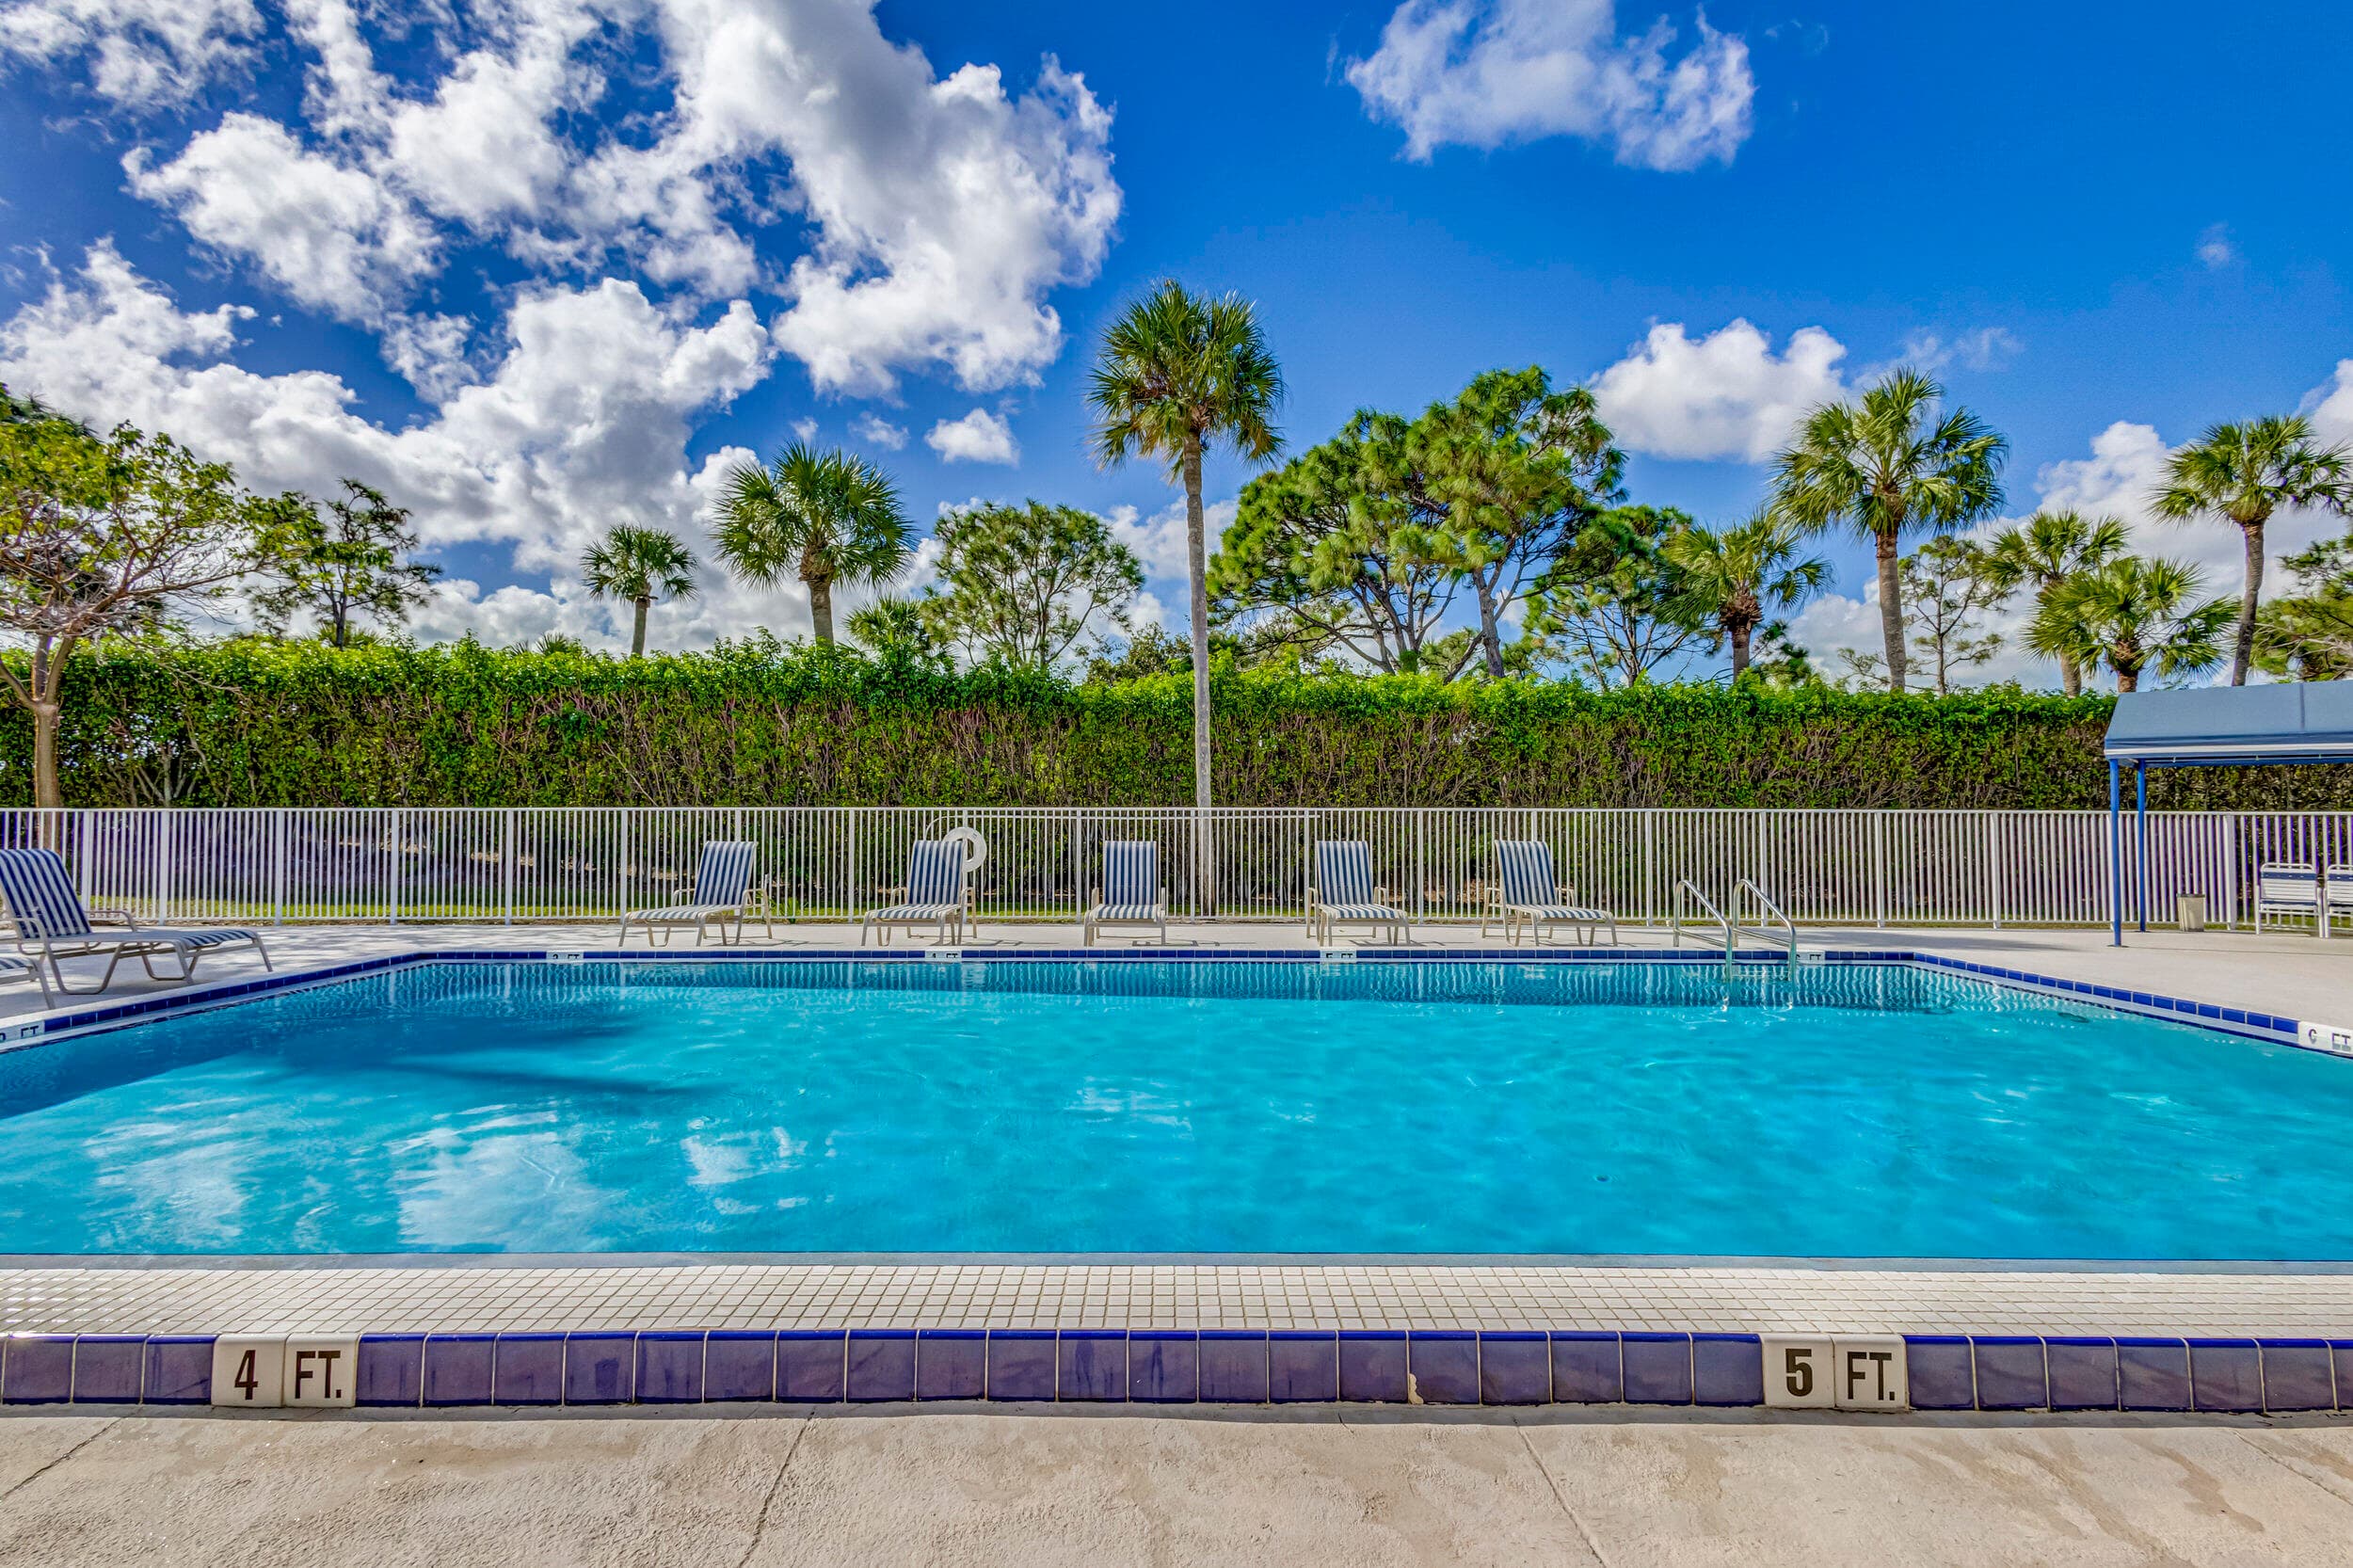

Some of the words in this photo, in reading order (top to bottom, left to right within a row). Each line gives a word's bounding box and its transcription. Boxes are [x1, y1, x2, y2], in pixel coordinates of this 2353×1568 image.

[234, 1350, 258, 1400] 4
[295, 1351, 342, 1399] FT.
[1785, 1348, 1813, 1397] 5
[1848, 1352, 1895, 1400] FT.
